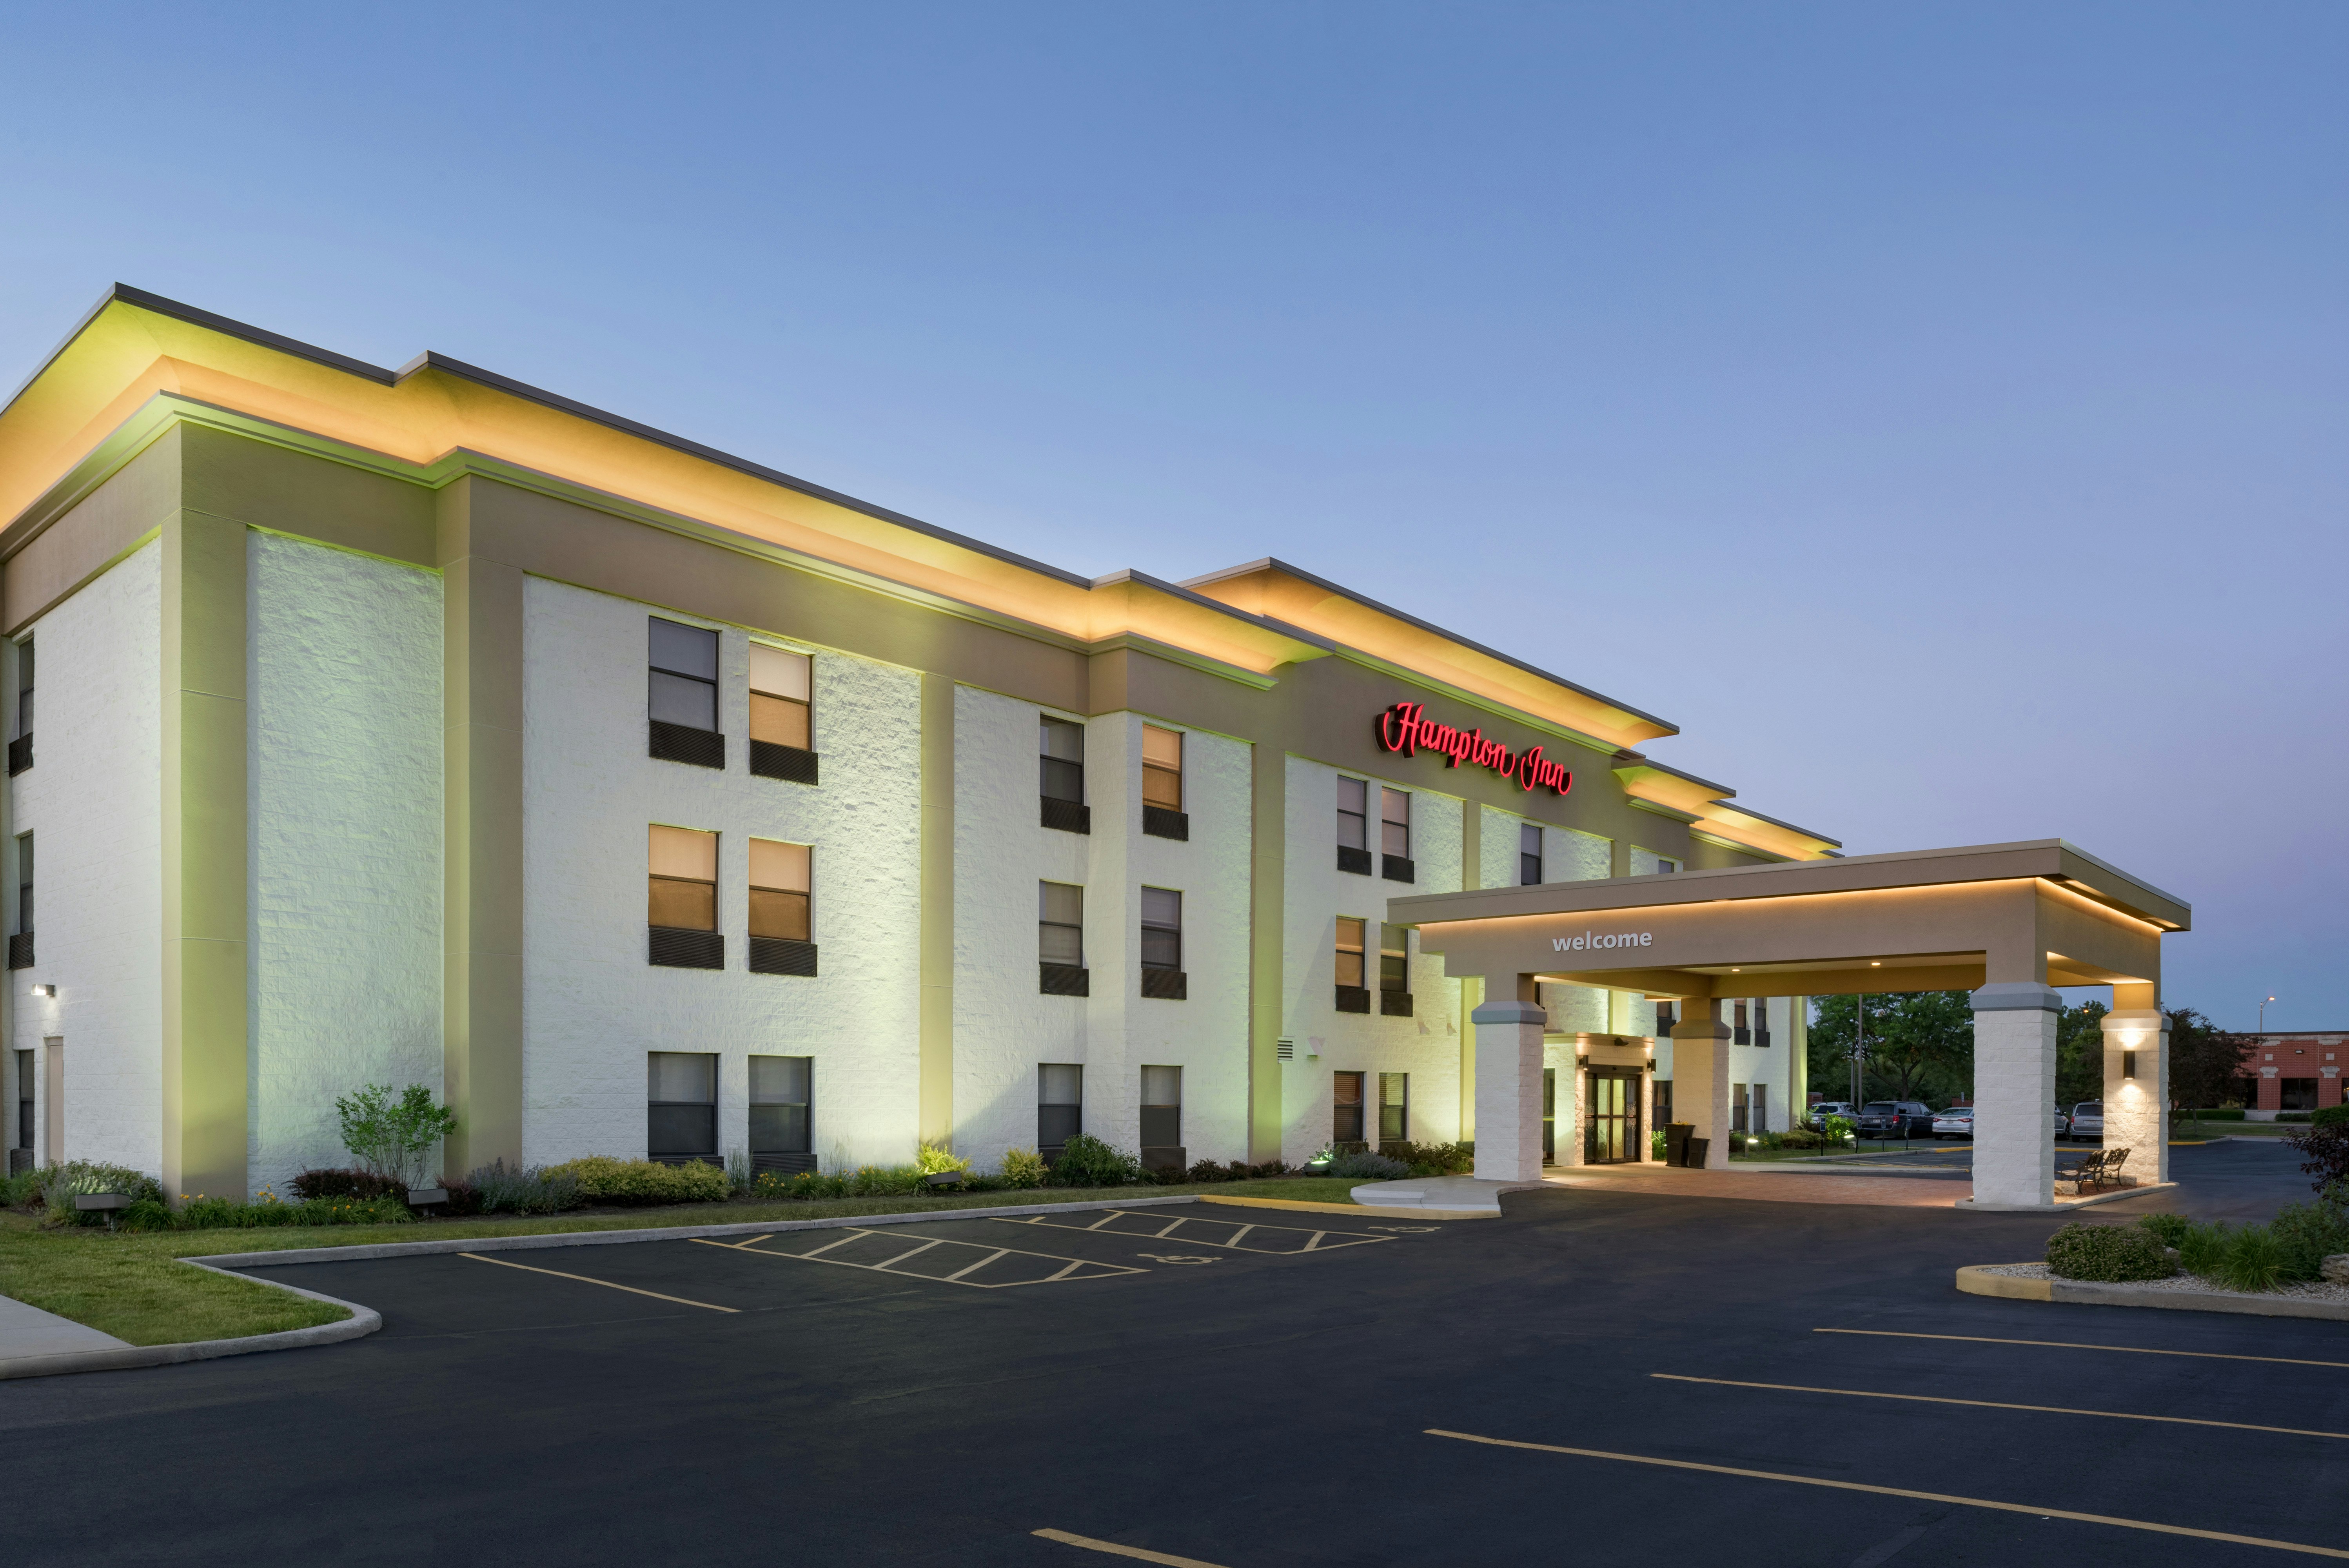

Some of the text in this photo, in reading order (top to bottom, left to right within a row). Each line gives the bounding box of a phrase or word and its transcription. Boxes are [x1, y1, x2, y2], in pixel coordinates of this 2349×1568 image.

[1383, 702, 1572, 795] Hampton Inn
[1552, 931, 1652, 952] welcome
